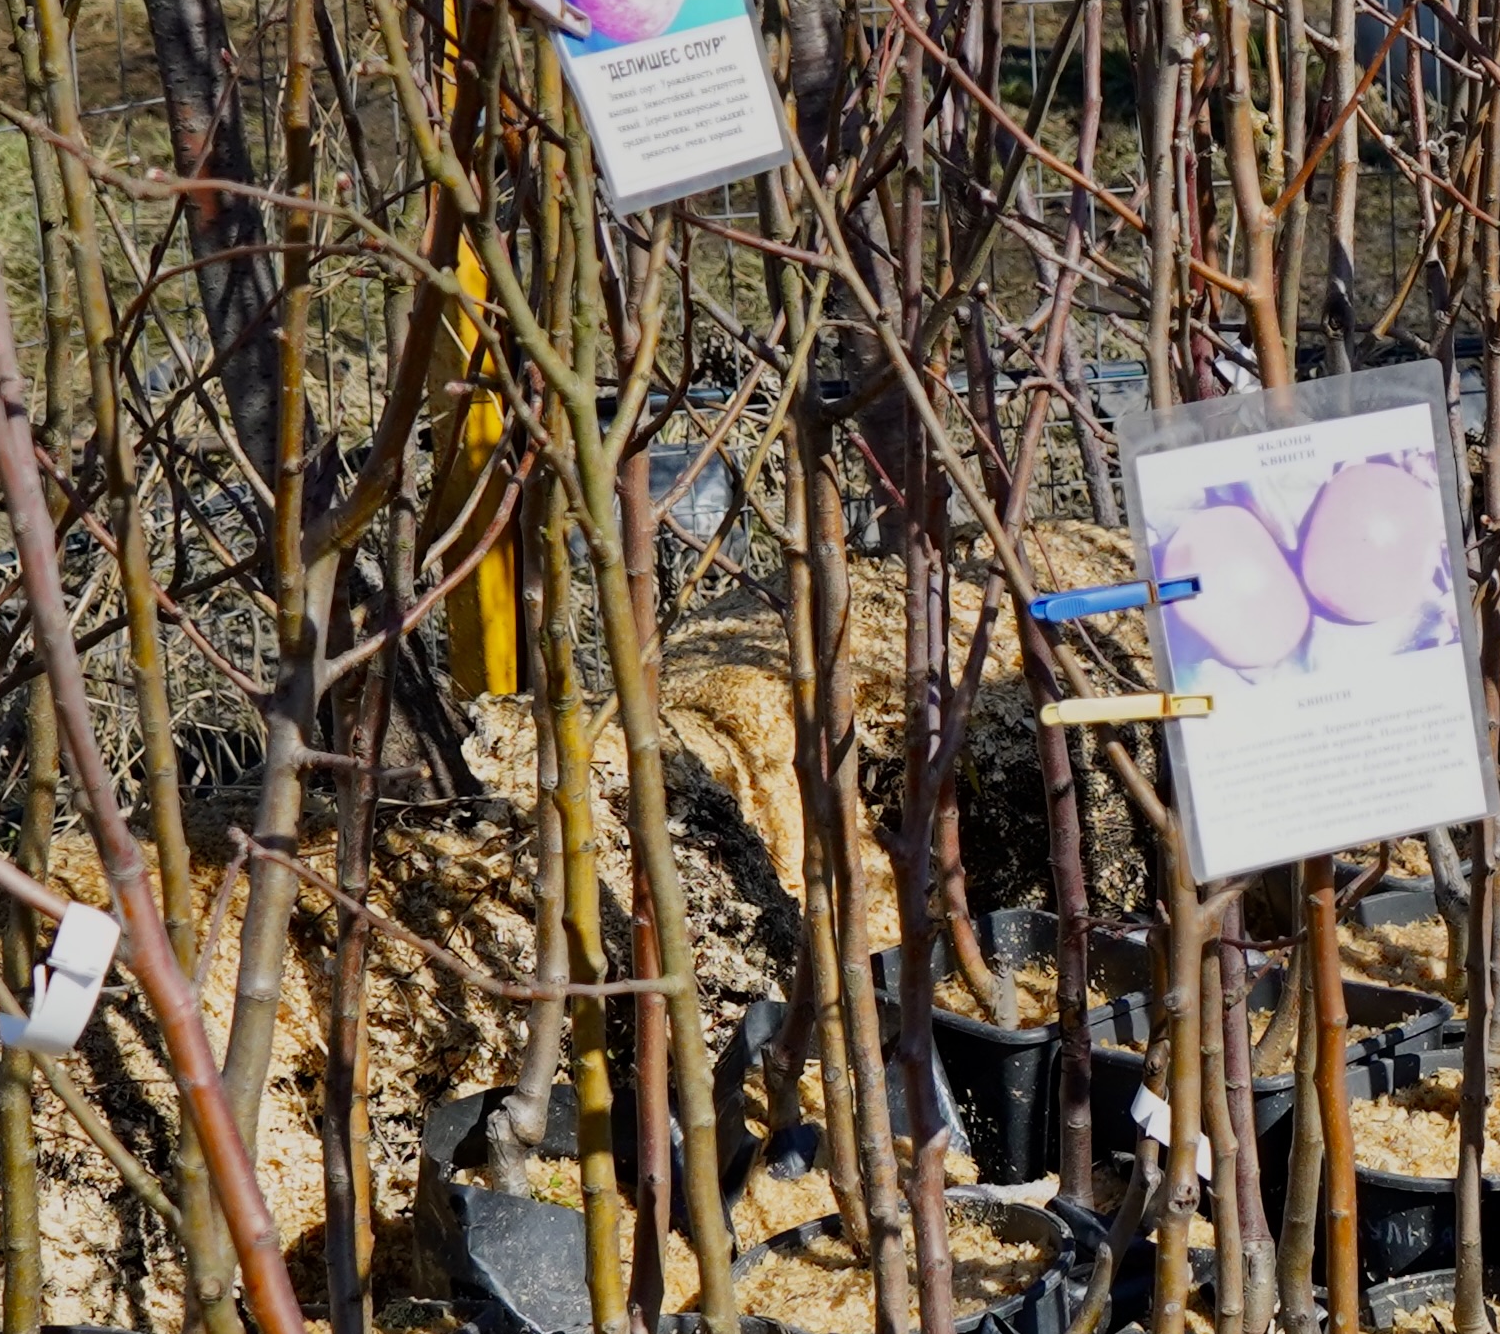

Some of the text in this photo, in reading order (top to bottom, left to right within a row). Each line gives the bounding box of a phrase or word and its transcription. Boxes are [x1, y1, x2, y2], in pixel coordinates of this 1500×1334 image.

[599, 34, 730, 85] "ДЕЛИШЕС СПУР"
[1256, 433, 1312, 453] ЯБЛОНЯ
[1259, 448, 1317, 468] КВИНТИ
[1294, 687, 1354, 710] КВИНТИ
